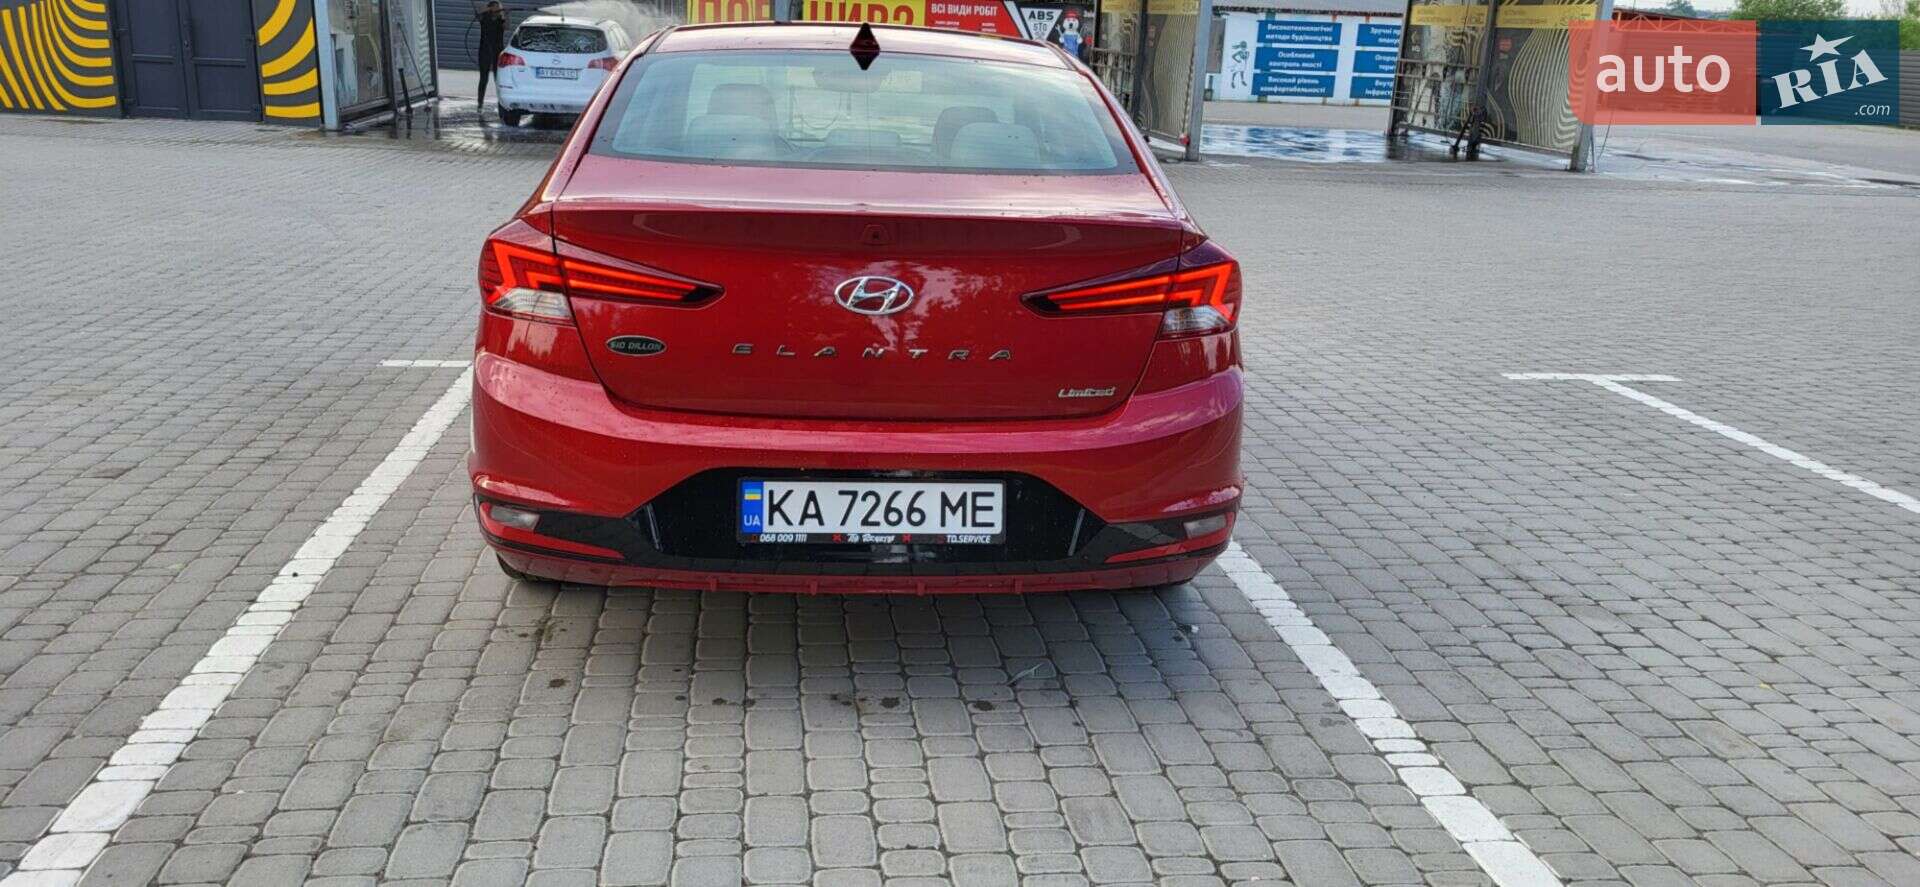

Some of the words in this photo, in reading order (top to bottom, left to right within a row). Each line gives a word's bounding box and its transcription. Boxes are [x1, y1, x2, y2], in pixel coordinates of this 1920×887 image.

[931, 3, 945, 14] ВСІ
[947, 4, 972, 16] ВИДИ
[974, 5, 997, 17] РОБІТ
[1029, 10, 1054, 20] ABS
[628, 341, 662, 351] DILLON
[732, 343, 1012, 361] ELANTRA
[1058, 386, 1116, 398] Limited
[744, 515, 761, 527] UA
[768, 489, 825, 526] KA
[838, 490, 926, 527] 7266
[940, 491, 995, 528] ME
[760, 534, 776, 543] 068
[777, 534, 793, 543] 009
